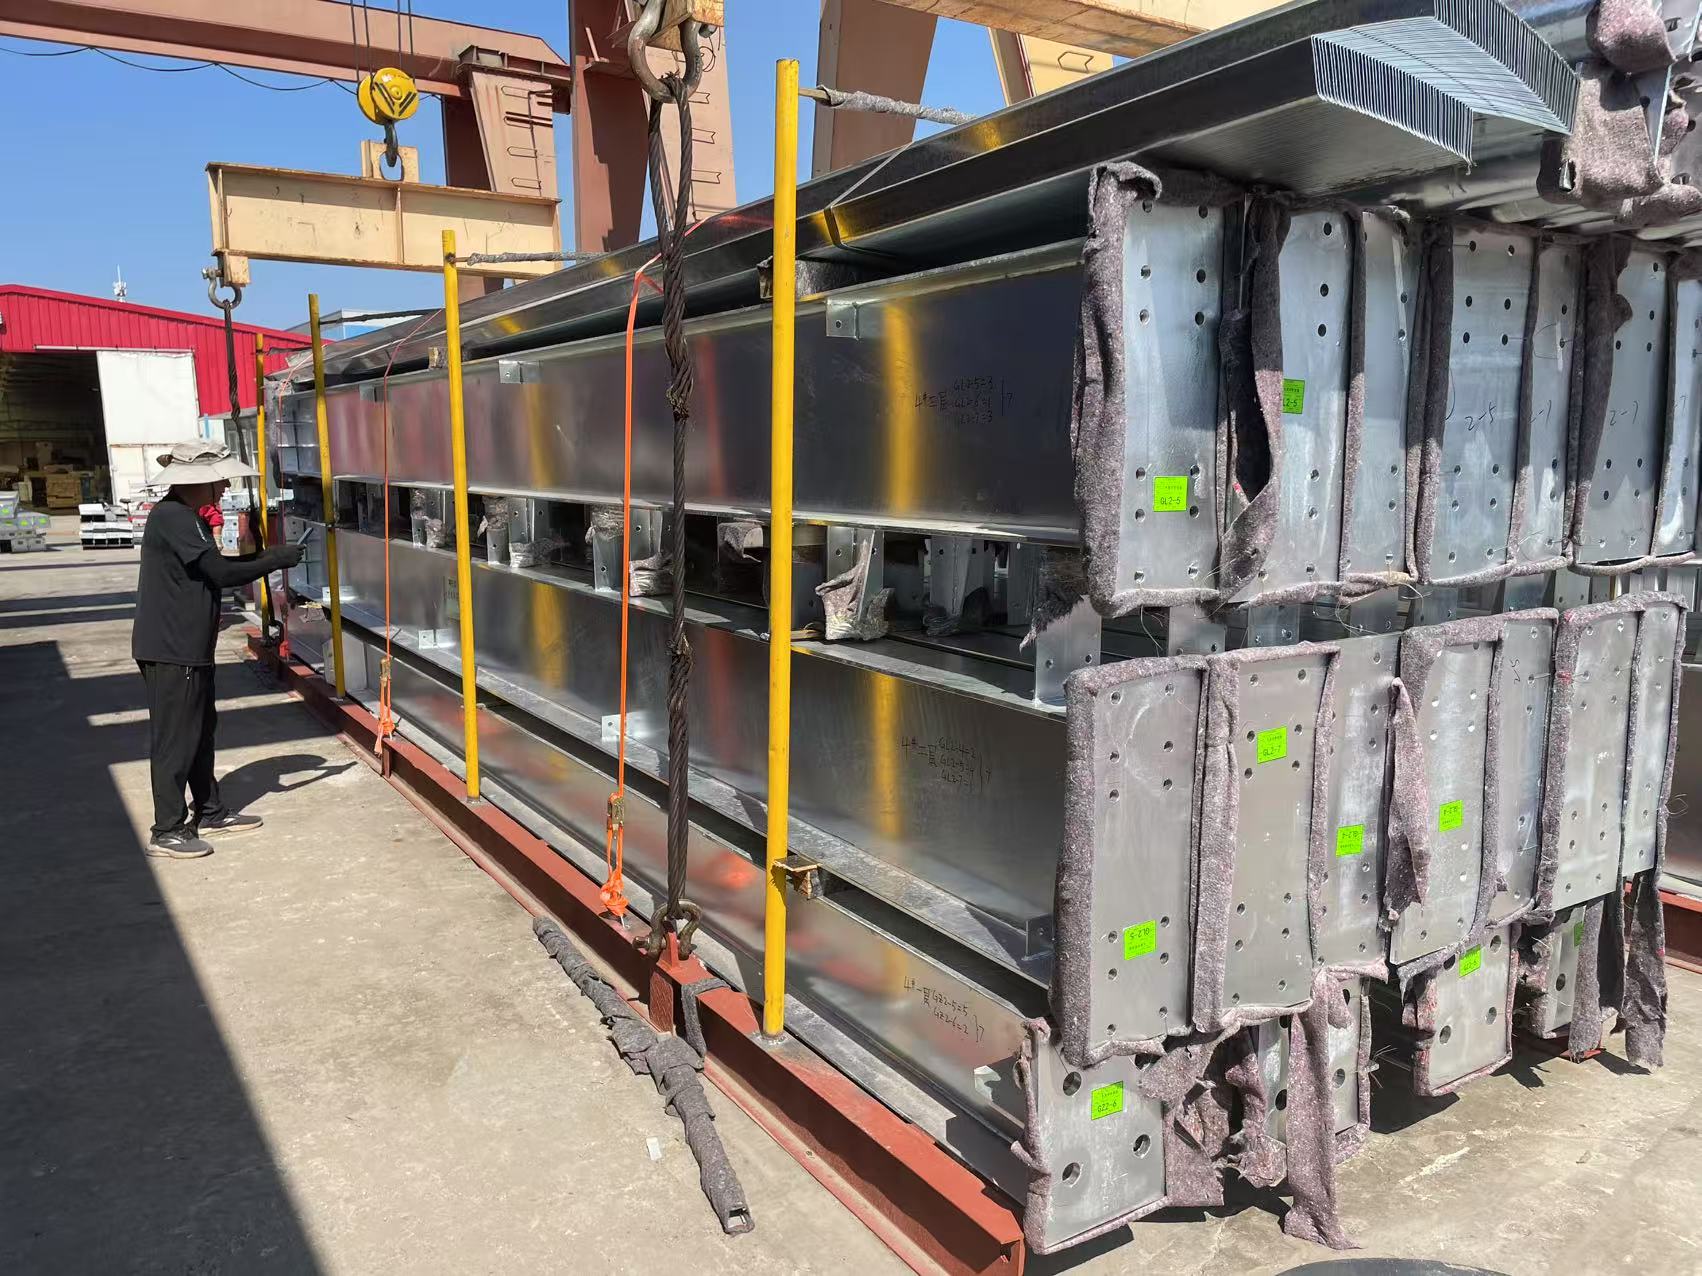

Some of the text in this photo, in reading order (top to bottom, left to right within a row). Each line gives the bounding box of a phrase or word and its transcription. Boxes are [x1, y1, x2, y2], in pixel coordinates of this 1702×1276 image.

[1283, 398, 1298, 408] L2-5
[1464, 401, 1497, 432] 2-5
[1160, 496, 1181, 505] GL2-5
